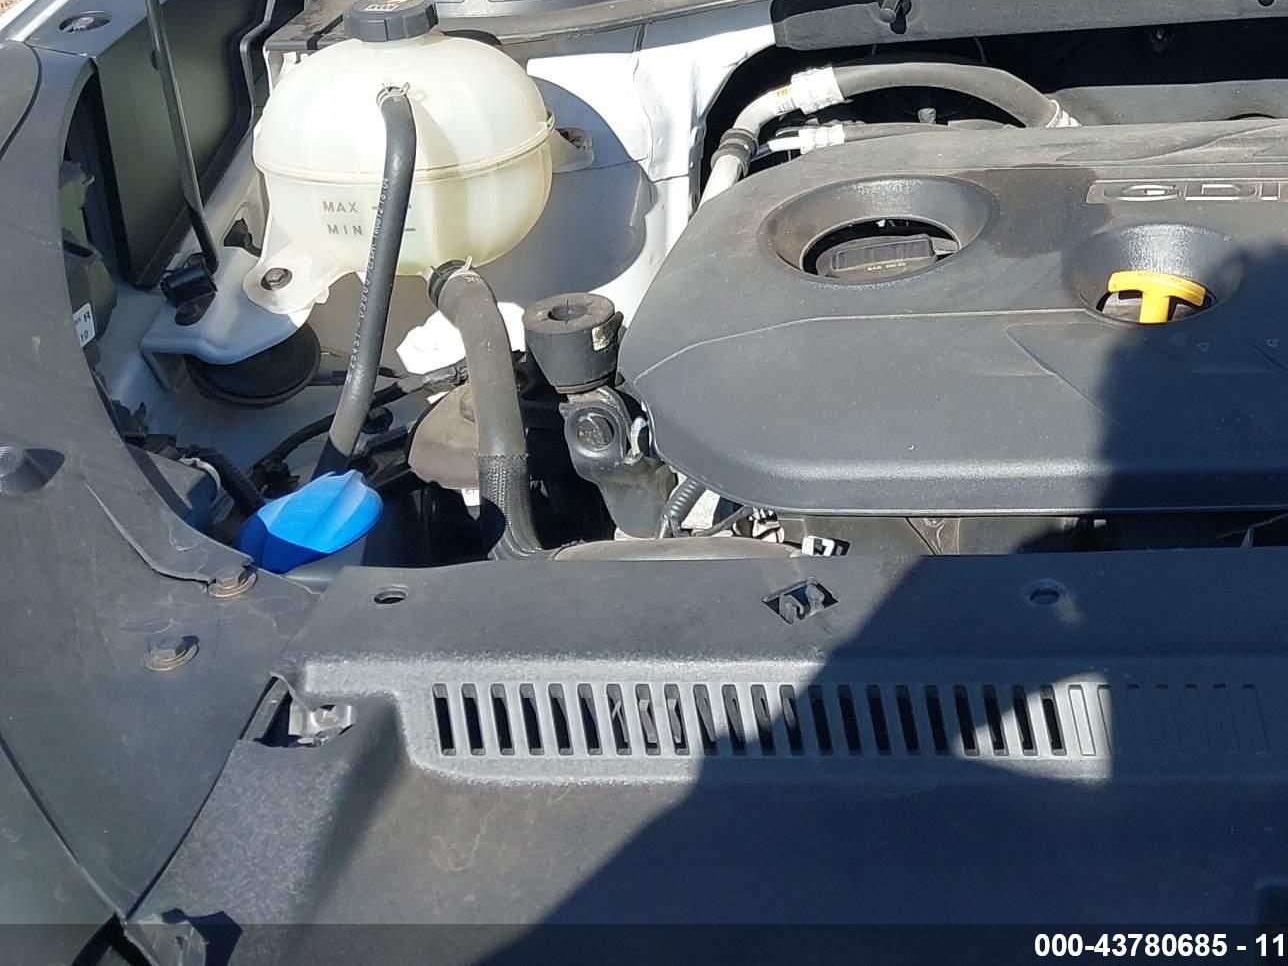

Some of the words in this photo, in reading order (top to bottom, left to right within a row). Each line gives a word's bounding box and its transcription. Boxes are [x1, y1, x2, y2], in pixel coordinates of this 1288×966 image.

[1103, 183, 1280, 202] GDI
[323, 201, 359, 213] MAX
[327, 224, 363, 236] MIN
